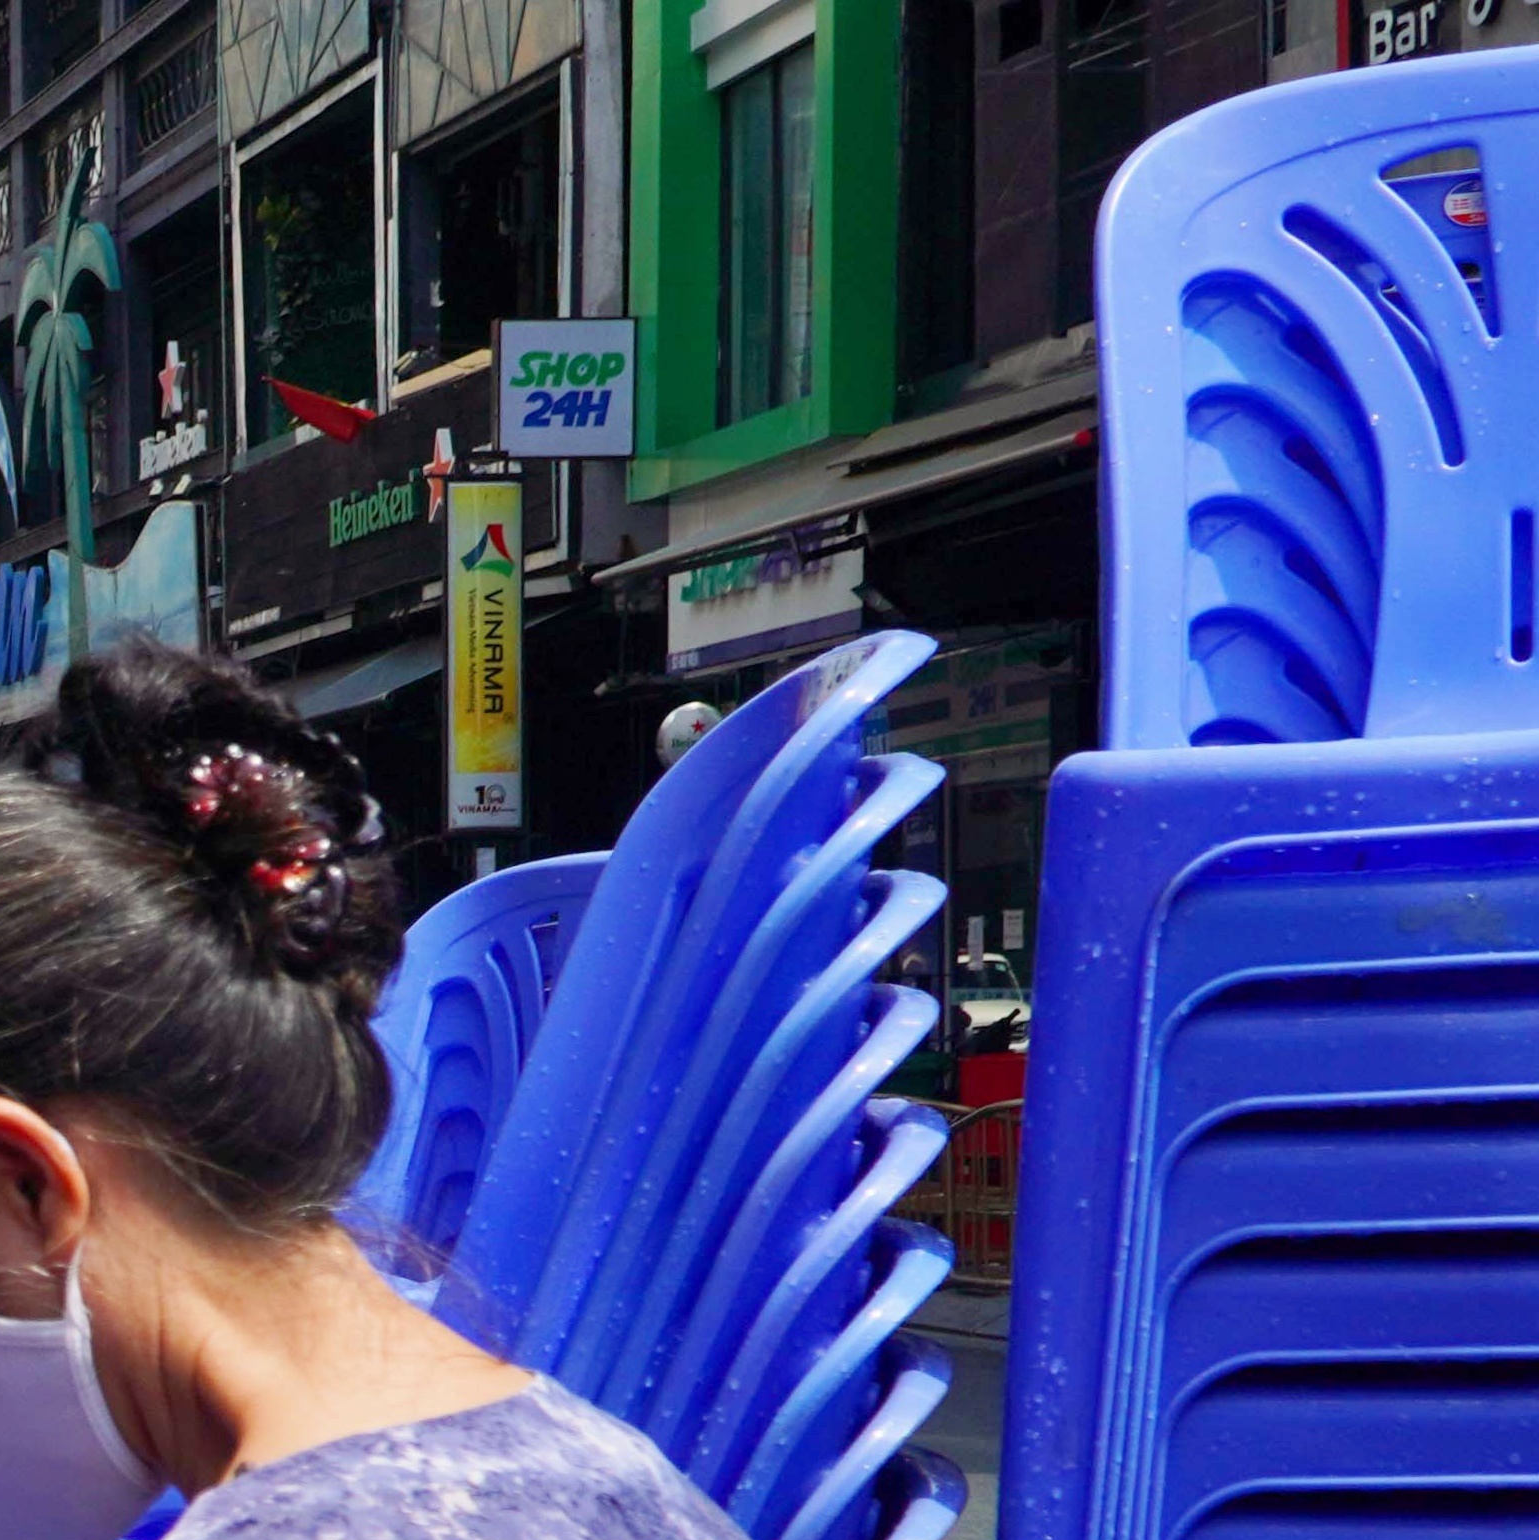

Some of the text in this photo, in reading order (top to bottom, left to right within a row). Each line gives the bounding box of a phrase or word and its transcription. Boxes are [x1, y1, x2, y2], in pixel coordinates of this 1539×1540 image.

[1369, 3, 1436, 64] Bar
[510, 351, 625, 387] SHOP
[522, 390, 612, 427] 24H
[329, 478, 415, 548] Heineken
[484, 588, 504, 714] VINAMA
